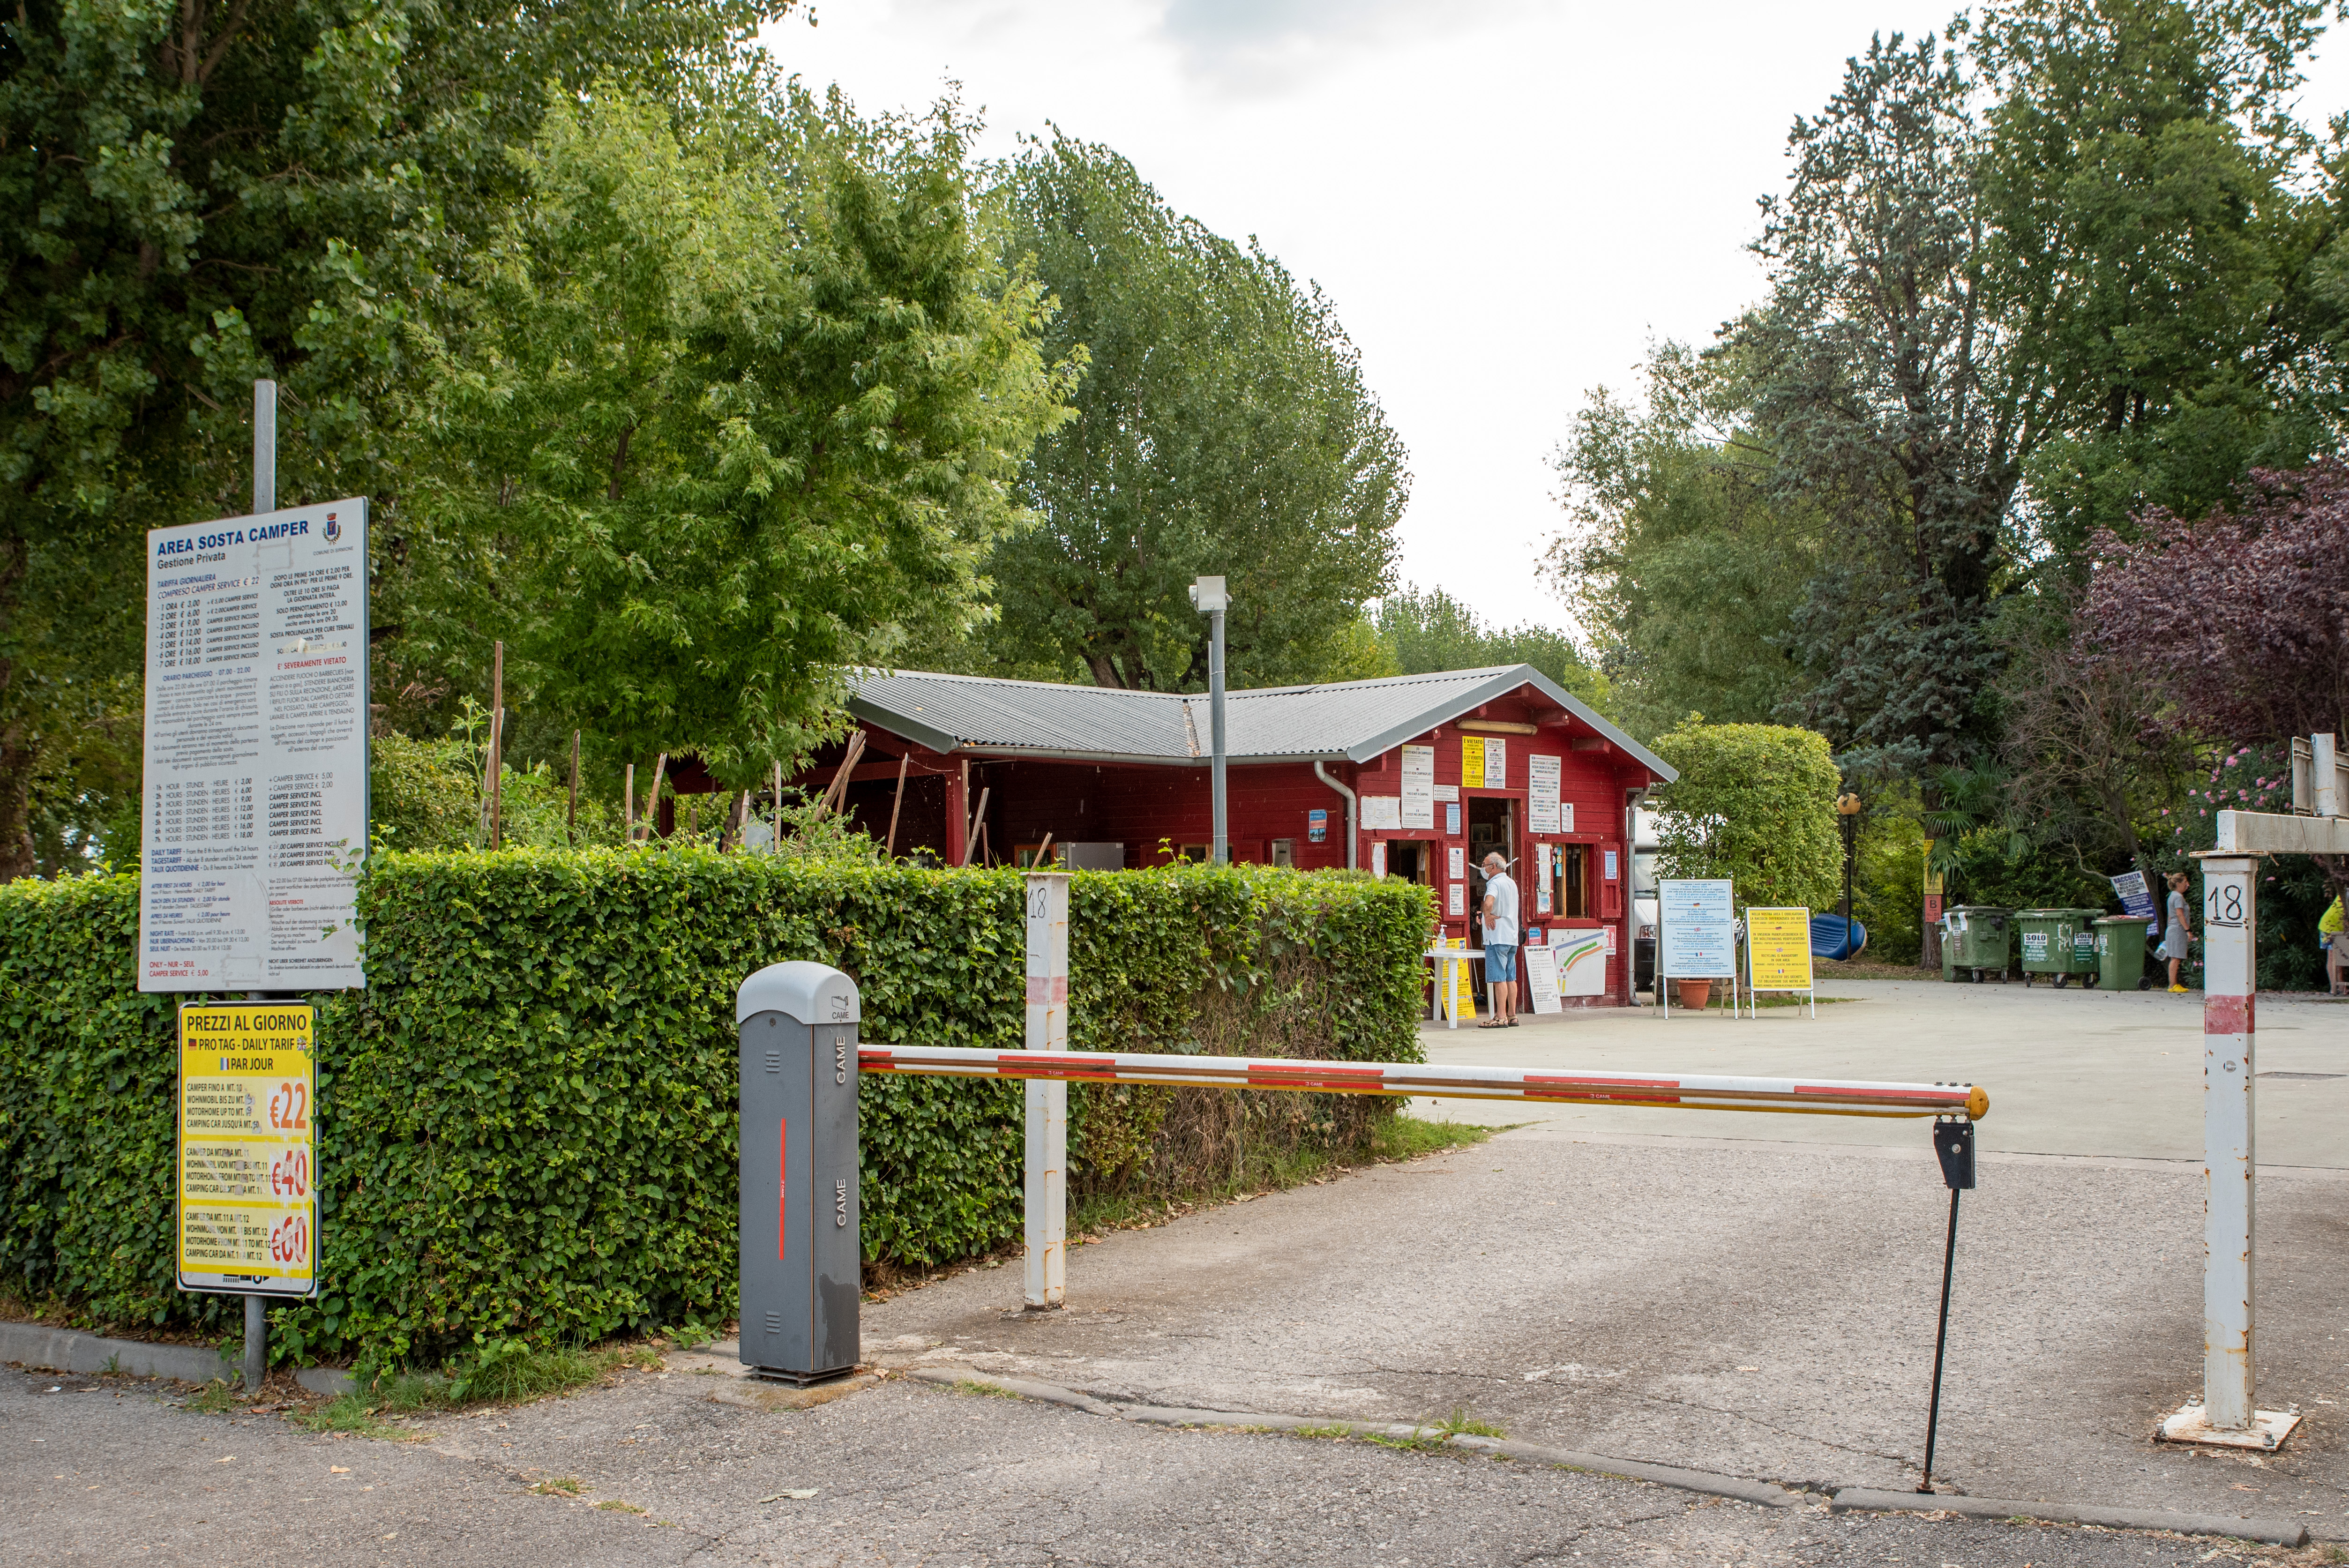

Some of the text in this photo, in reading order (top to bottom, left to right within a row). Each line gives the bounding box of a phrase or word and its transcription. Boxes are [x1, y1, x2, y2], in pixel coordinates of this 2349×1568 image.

[157, 520, 309, 556] AREA SOSTA CAMPER
[158, 552, 225, 569] Gestione Privata
[157, 574, 216, 588] TARIFFA GIORNALIERA
[157, 587, 190, 599] COMPRESO
[192, 583, 216, 593] CAMPER
[217, 579, 240, 590] SERVICE
[290, 603, 329, 613] PERNOTTAMENTO
[284, 659, 322, 670] SEVERAMENTE
[324, 657, 346, 665] VIETATO
[182, 671, 213, 679] PARCHEGGIO
[2113, 873, 2141, 884] RACCOLTA
[1028, 888, 1047, 918] 18
[1930, 900, 1937, 908] B
[2208, 885, 2242, 920] 18
[187, 1015, 307, 1031] PREZZI AL GIORNO
[199, 1038, 217, 1050] PRO
[218, 1038, 235, 1050] TAG
[243, 1038, 268, 1050] DAILY
[270, 1038, 294, 1050] TARIF
[231, 1058, 273, 1070] PAR JOUR
[836, 1036, 845, 1084] CAME
[187, 1107, 219, 1116] MOTORHOME
[236, 1108, 244, 1116] MT.
[270, 1083, 306, 1129] €22
[211, 1120, 221, 1128] CAR
[222, 1119, 242, 1129] JUSQU'À
[217, 1160, 228, 1169] VON
[272, 1150, 307, 1196] €40
[247, 1186, 256, 1194] MT.
[836, 1179, 846, 1226] CAME
[207, 1213, 213, 1221] DA
[217, 1225, 227, 1234] VON
[186, 1236, 217, 1246] MOTORHOME
[271, 1216, 307, 1262] €60
[186, 1248, 208, 1257] CAMPING
[209, 1249, 218, 1258] CAR
[219, 1250, 226, 1258] DA
